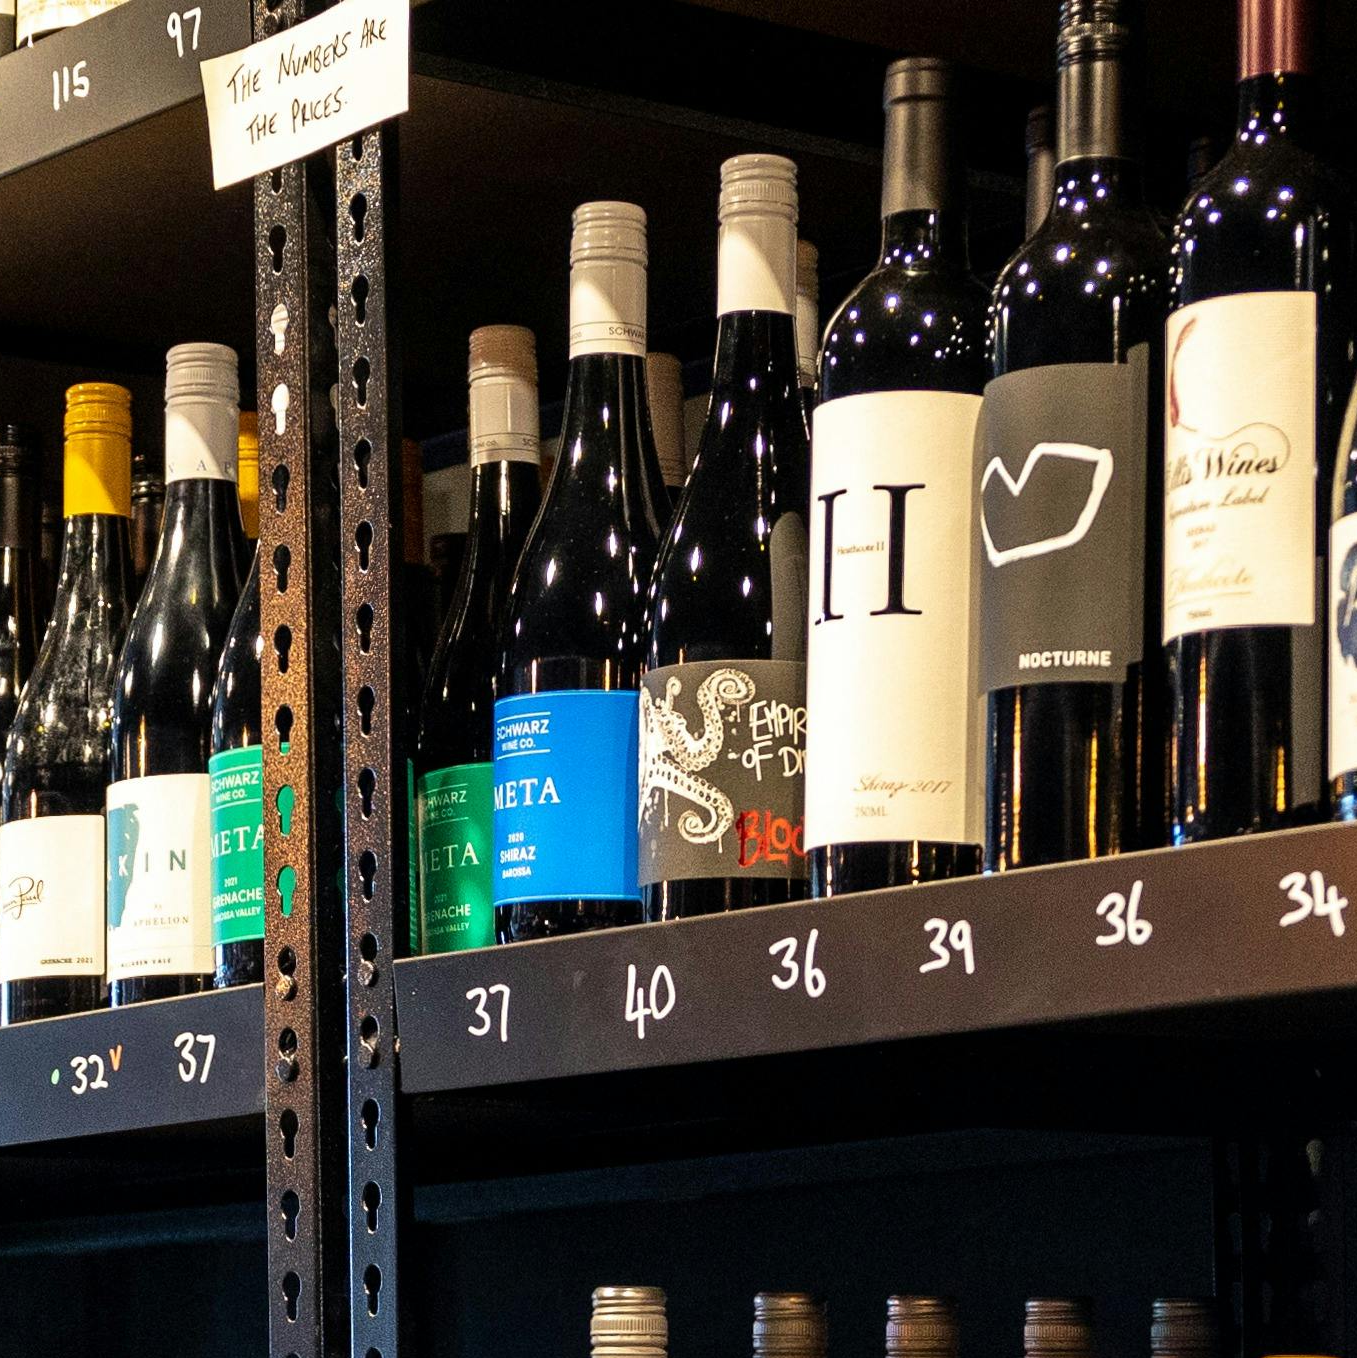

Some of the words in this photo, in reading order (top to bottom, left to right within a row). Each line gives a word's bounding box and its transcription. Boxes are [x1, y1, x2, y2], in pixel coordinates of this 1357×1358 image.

[165, 6, 202, 58] 97
[227, 64, 262, 104] THE
[278, 31, 352, 84] NUMBERS
[360, 18, 388, 49] ARE
[52, 60, 90, 111] 115
[246, 112, 278, 145] THE
[292, 86, 348, 134] PRICES.
[1198, 446, 1279, 480] Wines
[1019, 650, 1112, 670] NOCTURNE
[496, 719, 550, 742] SCHWARZ
[502, 740, 519, 752] WINE
[520, 738, 536, 750] CO.
[742, 740, 774, 781] OF
[211, 771, 260, 795] SCHWARZ
[233, 788, 248, 801] CO.
[494, 776, 561, 812] META
[852, 774, 910, 799] Shiraz
[911, 780, 953, 795] 2017
[500, 846, 537, 864] SHIRAZ
[508, 832, 525, 843] 2020
[224, 876, 238, 888] 2021
[502, 866, 532, 879] BAROSSA
[213, 886, 264, 910] GRENACHE
[236, 905, 262, 918] VALLEY
[1096, 881, 1153, 945] 36
[1278, 870, 1348, 937] 34
[76, 956, 94, 965] 2021
[769, 929, 826, 998] 36
[919, 918, 976, 974] 39
[465, 984, 510, 1042] 37
[624, 964, 676, 1039] 40
[70, 1053, 108, 1095] 32
[174, 1032, 216, 1084] 37
